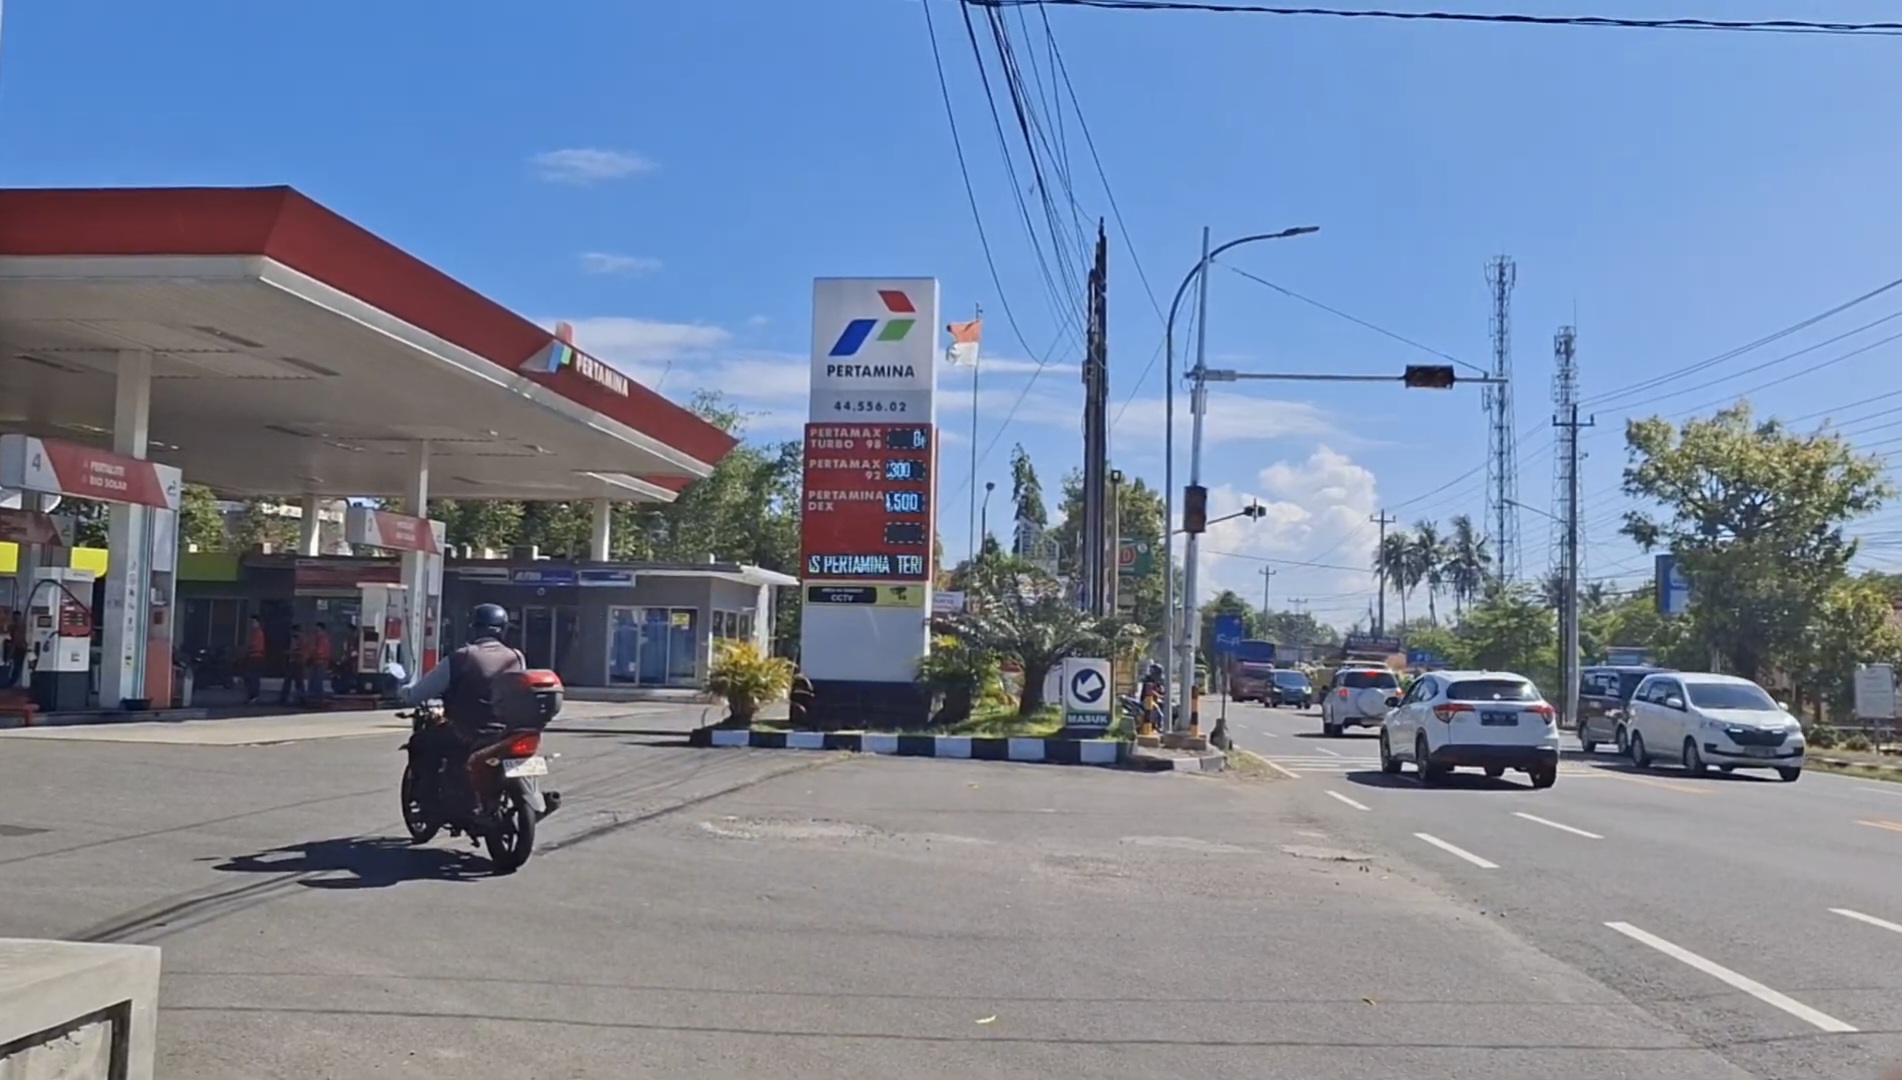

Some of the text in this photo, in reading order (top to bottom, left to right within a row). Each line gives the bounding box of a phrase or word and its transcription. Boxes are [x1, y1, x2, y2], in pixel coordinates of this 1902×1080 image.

[575, 352, 629, 397] PERTAMINA
[826, 364, 915, 378] PERTAMINA
[834, 401, 907, 412] 44.556.02
[809, 428, 881, 438] PERTAMAX
[811, 439, 882, 449] TURBO 98
[32, 452, 42, 472] 4
[809, 459, 881, 469] PERTAMAX
[865, 470, 881, 480] 92
[90, 476, 128, 491] BIO SOLAR
[808, 490, 885, 501] PERTAMINA
[808, 501, 834, 511] DEX
[823, 555, 891, 574] PERTAMINA
[896, 555, 923, 574] TERI
[830, 594, 854, 602] CCTV
[1068, 714, 1109, 724] MASUK
